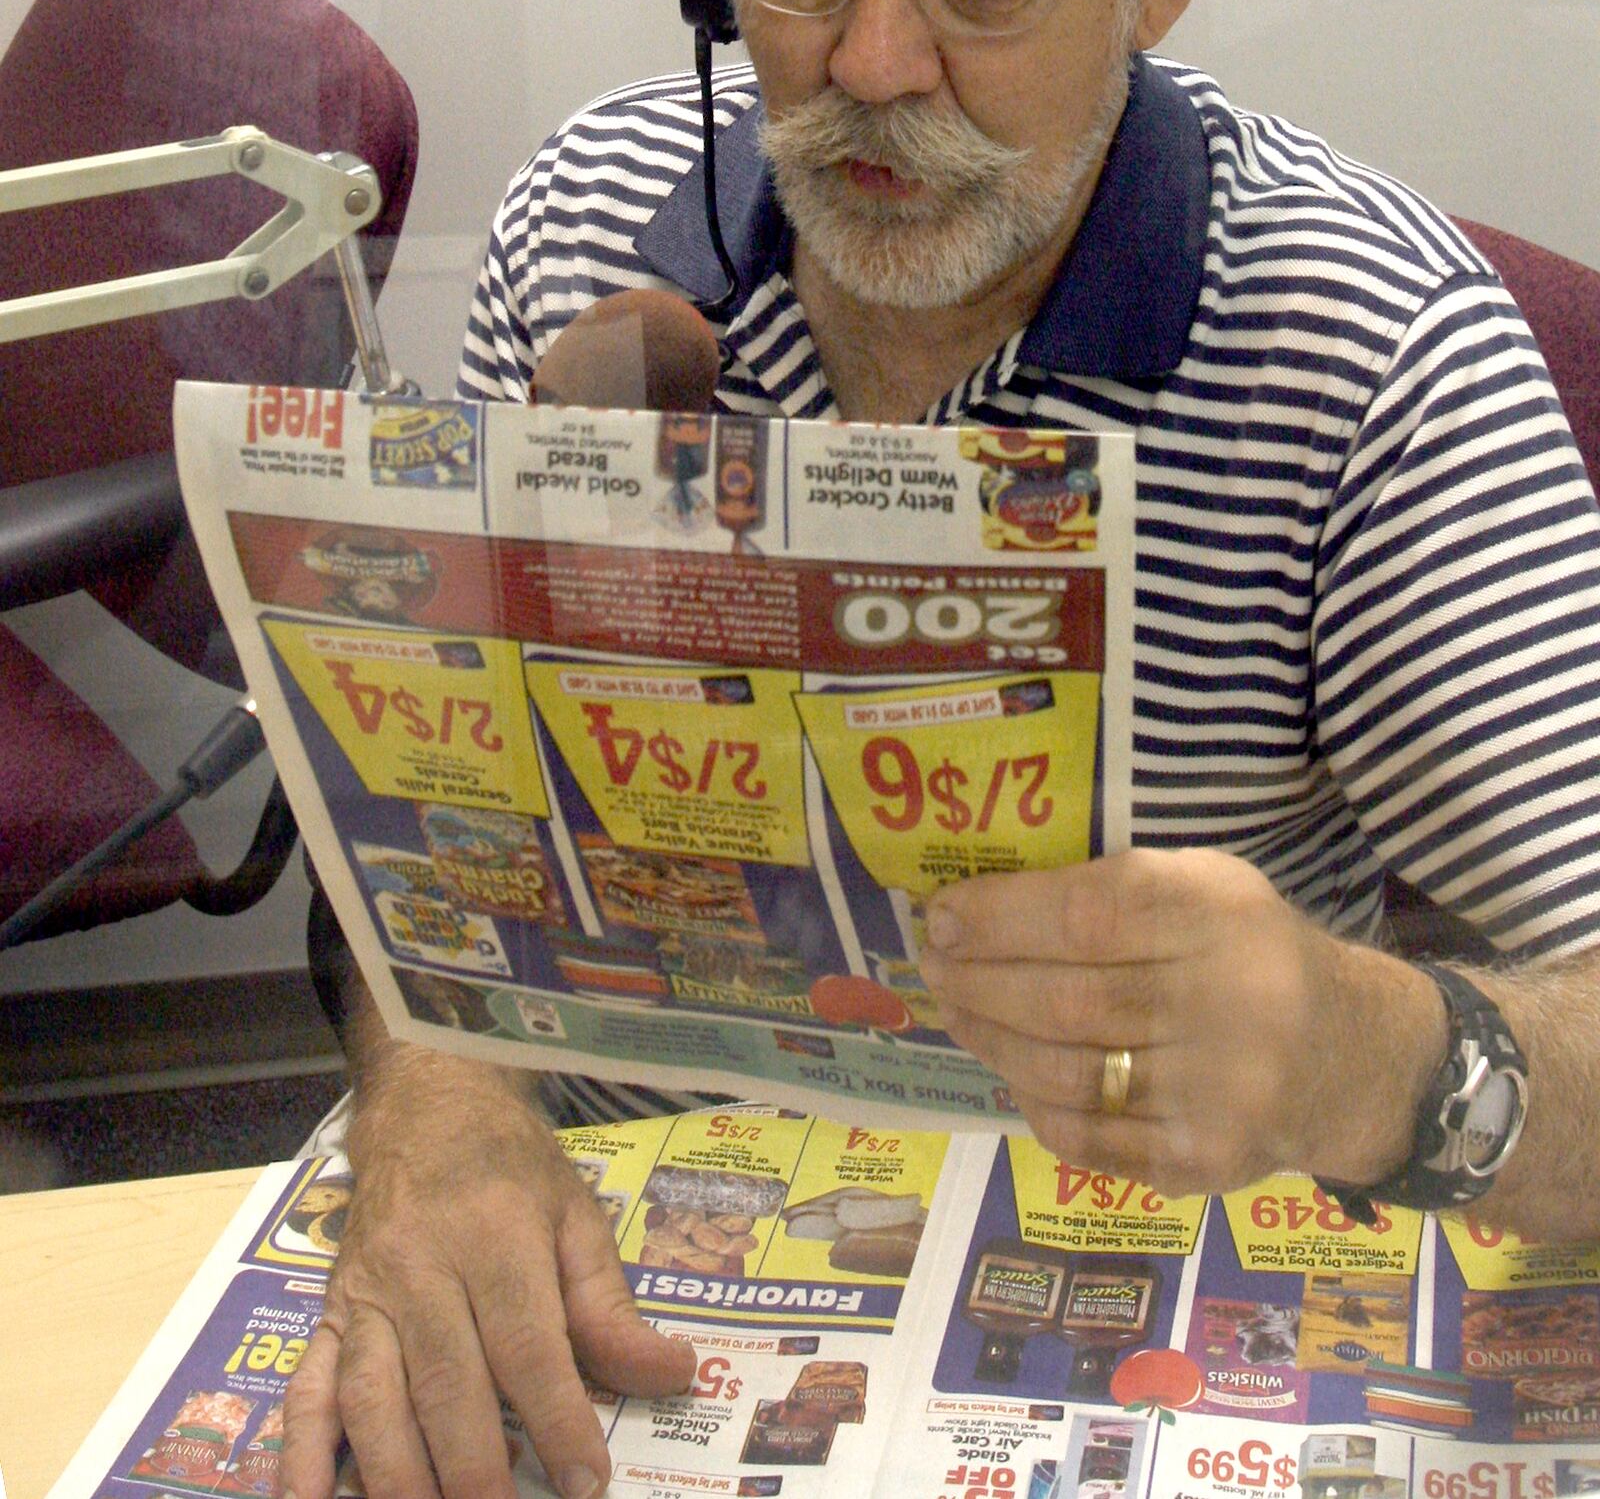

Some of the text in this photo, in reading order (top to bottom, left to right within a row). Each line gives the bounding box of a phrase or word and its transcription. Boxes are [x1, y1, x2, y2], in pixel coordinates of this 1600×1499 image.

[245, 386, 344, 449] Free!
[369, 415, 474, 468] POP SECRET
[580, 437, 632, 451] Assorted
[548, 450, 608, 472] Bread
[882, 451, 937, 463] Assorted
[517, 471, 640, 498] Gold Medal
[804, 461, 957, 490] Warm Delights
[807, 489, 955, 513] Betty Crocker
[833, 573, 1067, 593] Bonus Points
[841, 594, 1053, 643] 200
[987, 644, 1067, 663] Get
[323, 660, 504, 753] 2/$4
[581, 702, 767, 801] 2/$4
[414, 765, 480, 787] Cereals
[861, 736, 1053, 834] 2/$6
[395, 777, 513, 805] General Mills
[640, 818, 762, 843] Granola Bars
[643, 829, 771, 858] Nature Valley
[432, 856, 545, 889] Charms
[920, 862, 970, 879] Rolls
[462, 877, 543, 911] Lucky
[799, 1064, 987, 1111] Bonus Box Tops
[706, 1115, 762, 1141] 2/$5
[571, 1137, 637, 1150] Sliced Loaf
[845, 1126, 901, 1153] 2/$4
[578, 1145, 618, 1157] Bakery
[688, 1150, 753, 1164] Schnecken
[670, 1155, 781, 1175] Bowties, Bearclaws
[834, 1165, 903, 1175] Loaf Breads
[838, 1173, 894, 1183] Wide Pan
[1025, 1211, 1184, 1233] Montgomery Inn BBQ Sauce
[1023, 1227, 1183, 1249] LaRosa's Salad Dressing
[1247, 1244, 1406, 1259] or Whiskas Dry Cat Food
[1250, 1254, 1405, 1270] Pedigree Dry Dog Food
[989, 1270, 1050, 1288] Sauce
[634, 1273, 863, 1313] Favorites!
[1076, 1286, 1138, 1300] Sauce
[252, 1305, 308, 1324] Shrimp
[245, 1318, 310, 1337] Cooked
[224, 1332, 309, 1375] ee!
[732, 1341, 743, 1350] TO
[745, 1341, 754, 1350] UP
[755, 1340, 774, 1351] SAVE
[1207, 1371, 1284, 1389] whiskas
[698, 1403, 733, 1414] Frozen,
[959, 1403, 971, 1412] The
[972, 1403, 996, 1414] Reflects
[996, 1404, 1006, 1415] Tag
[1006, 1405, 1025, 1415] Shelf
[1257, 1396, 1287, 1406] NEW!
[652, 1415, 720, 1433] Chicken
[690, 1411, 732, 1421] Assorted
[1523, 1406, 1580, 1424] DISH
[926, 1424, 956, 1434] Scents
[944, 1417, 1039, 1432] and Glade Light Show
[956, 1426, 987, 1436] Candle
[651, 1428, 711, 1446] Kroger
[952, 1434, 1023, 1451] Air Care
[1013, 1428, 1052, 1441] Including
[161, 1442, 217, 1460] SHRIMP
[956, 1448, 1011, 1463] Glade
[1187, 1440, 1297, 1490] $599
[625, 1467, 731, 1490] Shelf Tag Reflects The Savings
[944, 1465, 1016, 1487] OFF
[652, 1489, 662, 1497] ct
[1212, 1484, 1247, 1496] Bottles
[1268, 1491, 1286, 1499] 187
